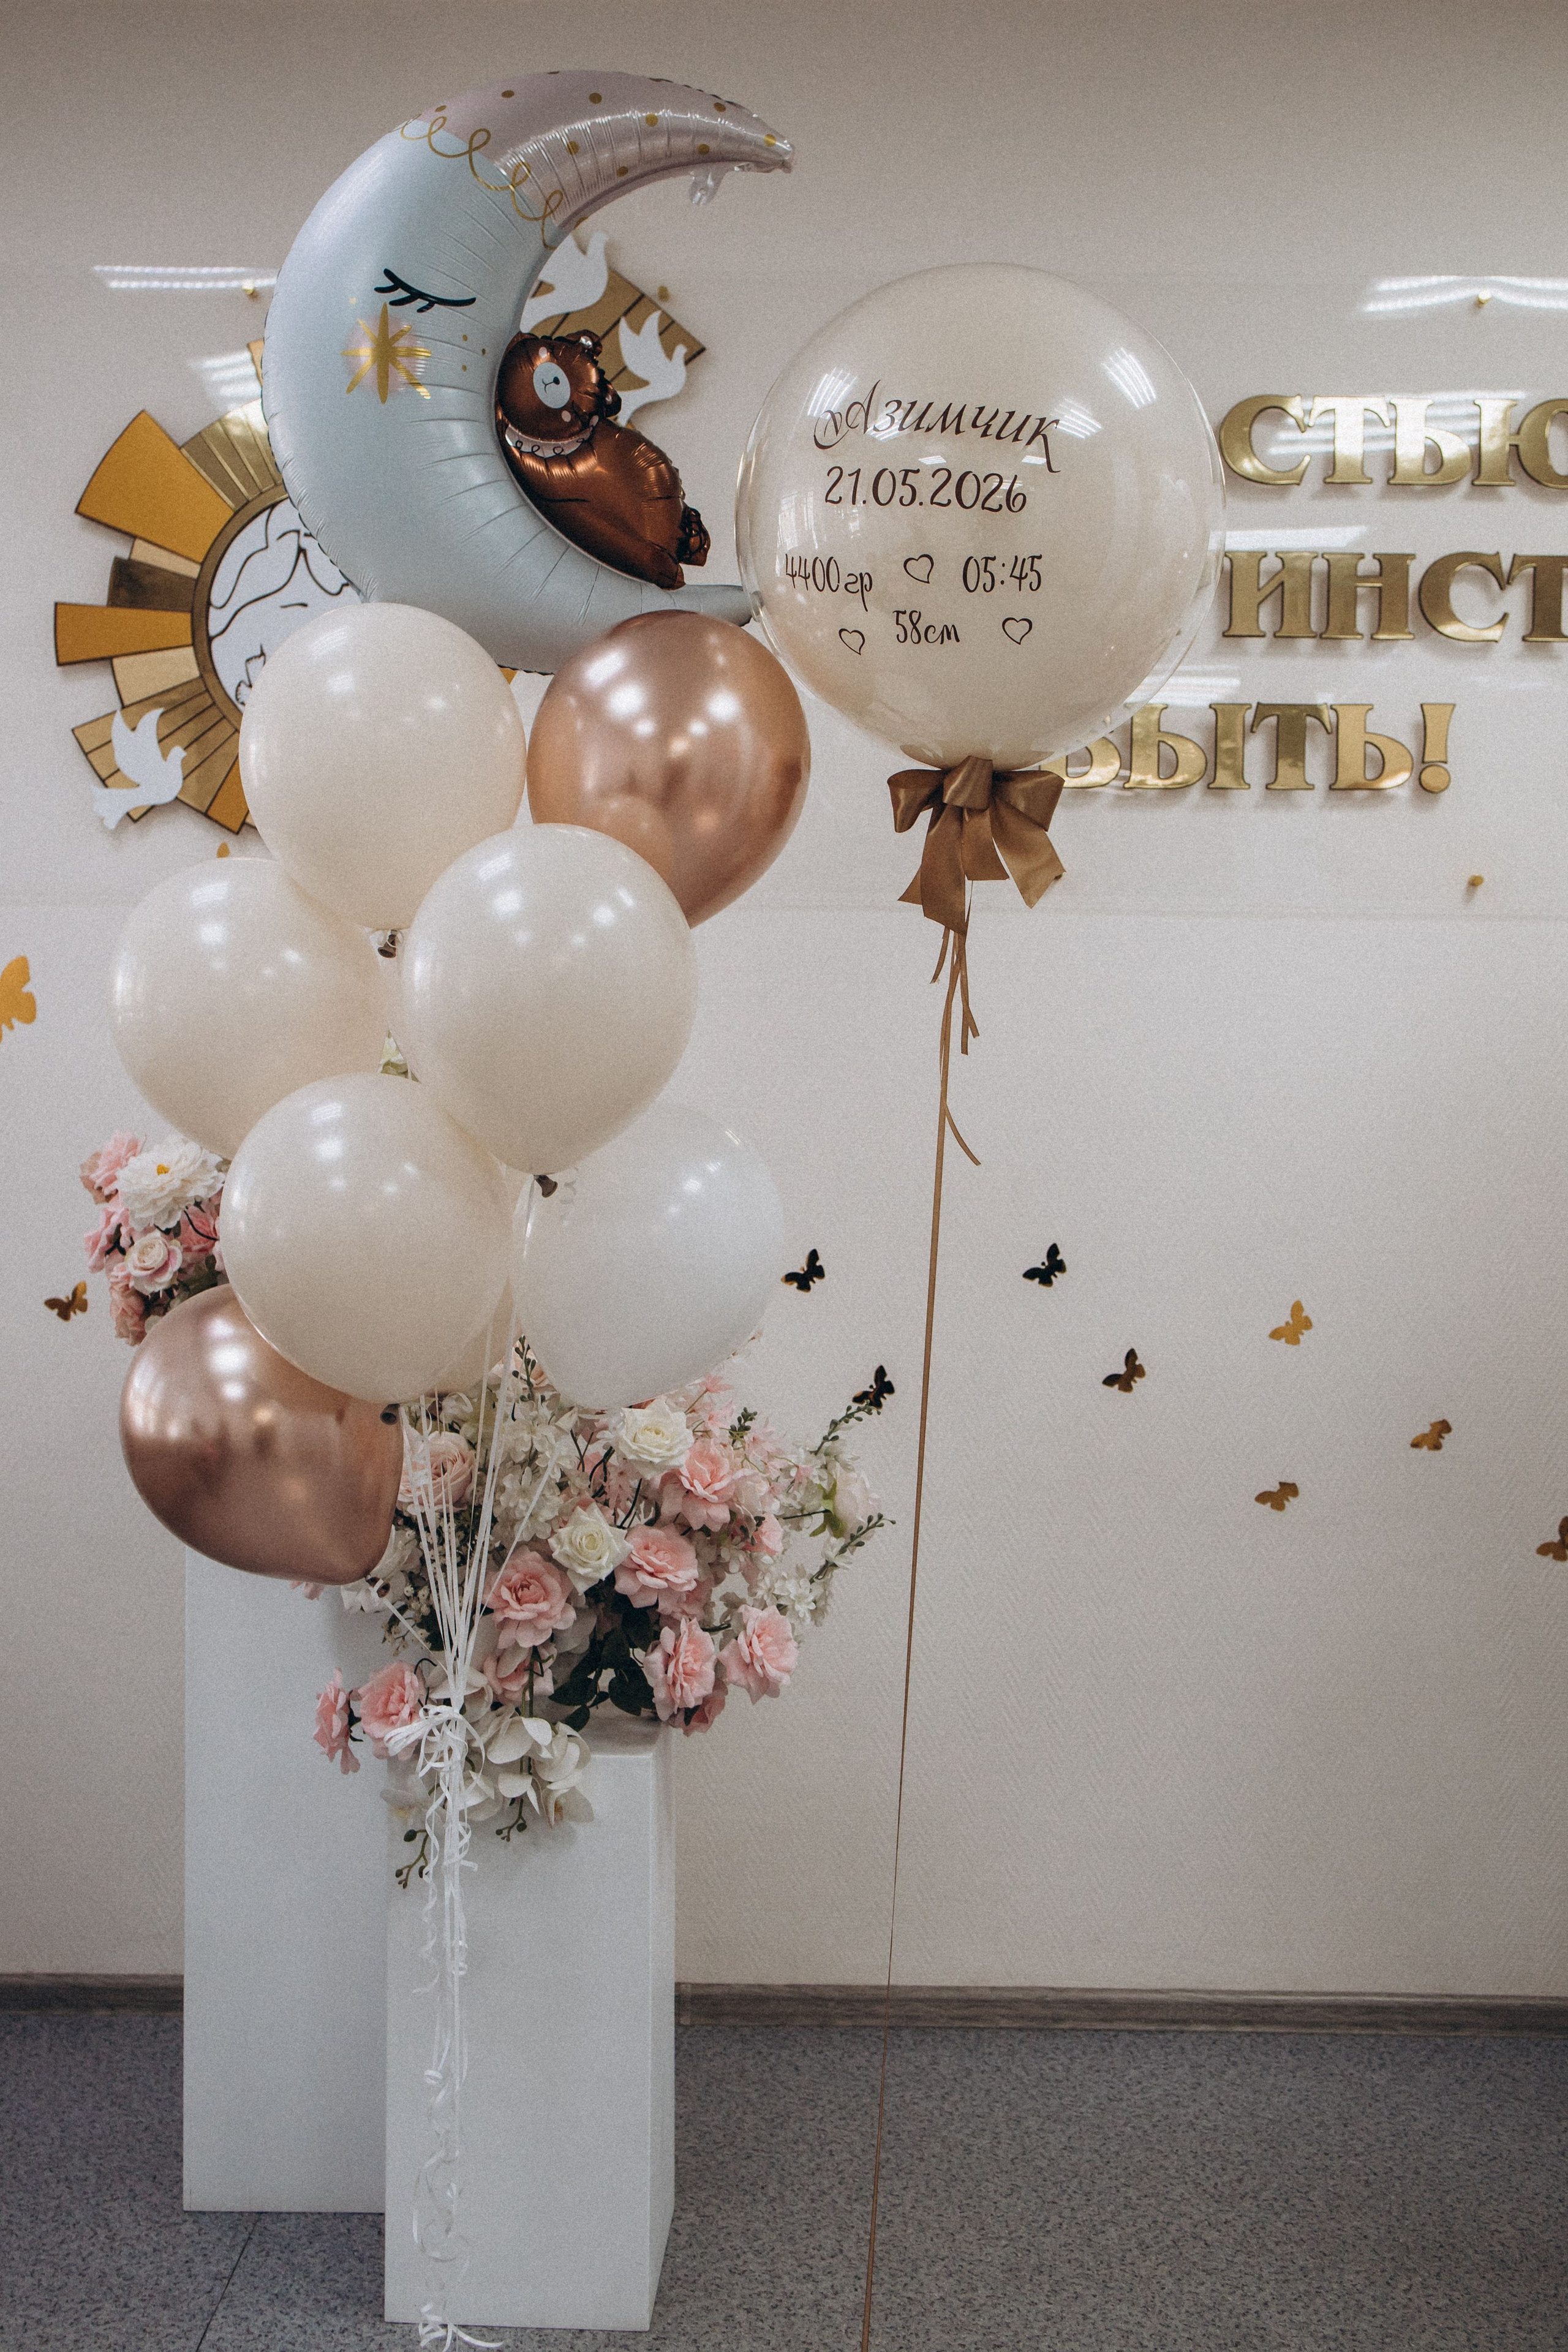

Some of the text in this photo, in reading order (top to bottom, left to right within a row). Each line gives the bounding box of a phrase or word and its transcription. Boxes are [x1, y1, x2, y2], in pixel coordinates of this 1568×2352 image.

[813, 379, 1061, 473] Азимчик
[825, 466, 1027, 513] 21.05.2026
[962, 554, 1042, 593] 05:45
[892, 610, 960, 644] 58см
